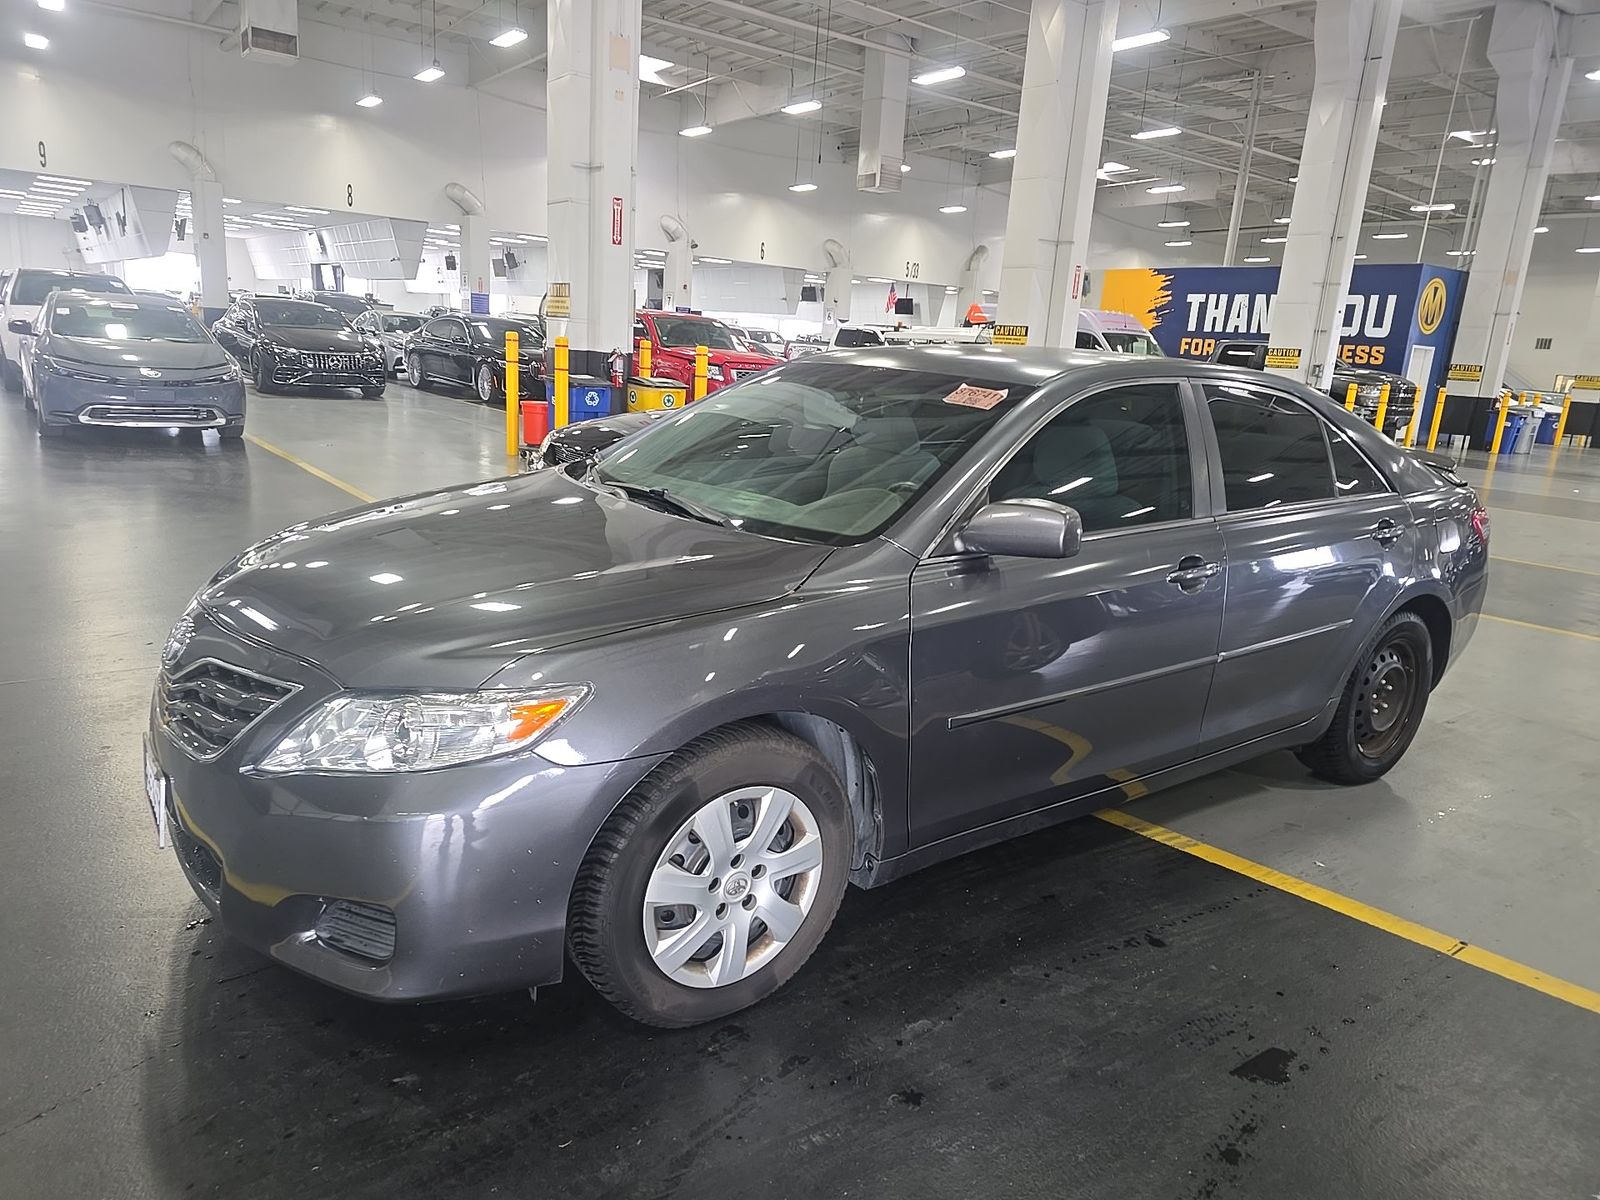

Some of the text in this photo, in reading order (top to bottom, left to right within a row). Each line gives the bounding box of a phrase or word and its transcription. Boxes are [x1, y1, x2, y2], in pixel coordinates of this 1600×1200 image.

[38, 141, 47, 168] 9
[347, 184, 354, 208] 8
[760, 242, 765, 260] 6
[995, 325, 1027, 336] CAUTION
[1179, 337, 1216, 356] FOR
[1268, 348, 1300, 357] CAUTION
[1451, 364, 1482, 372] CAUTION
